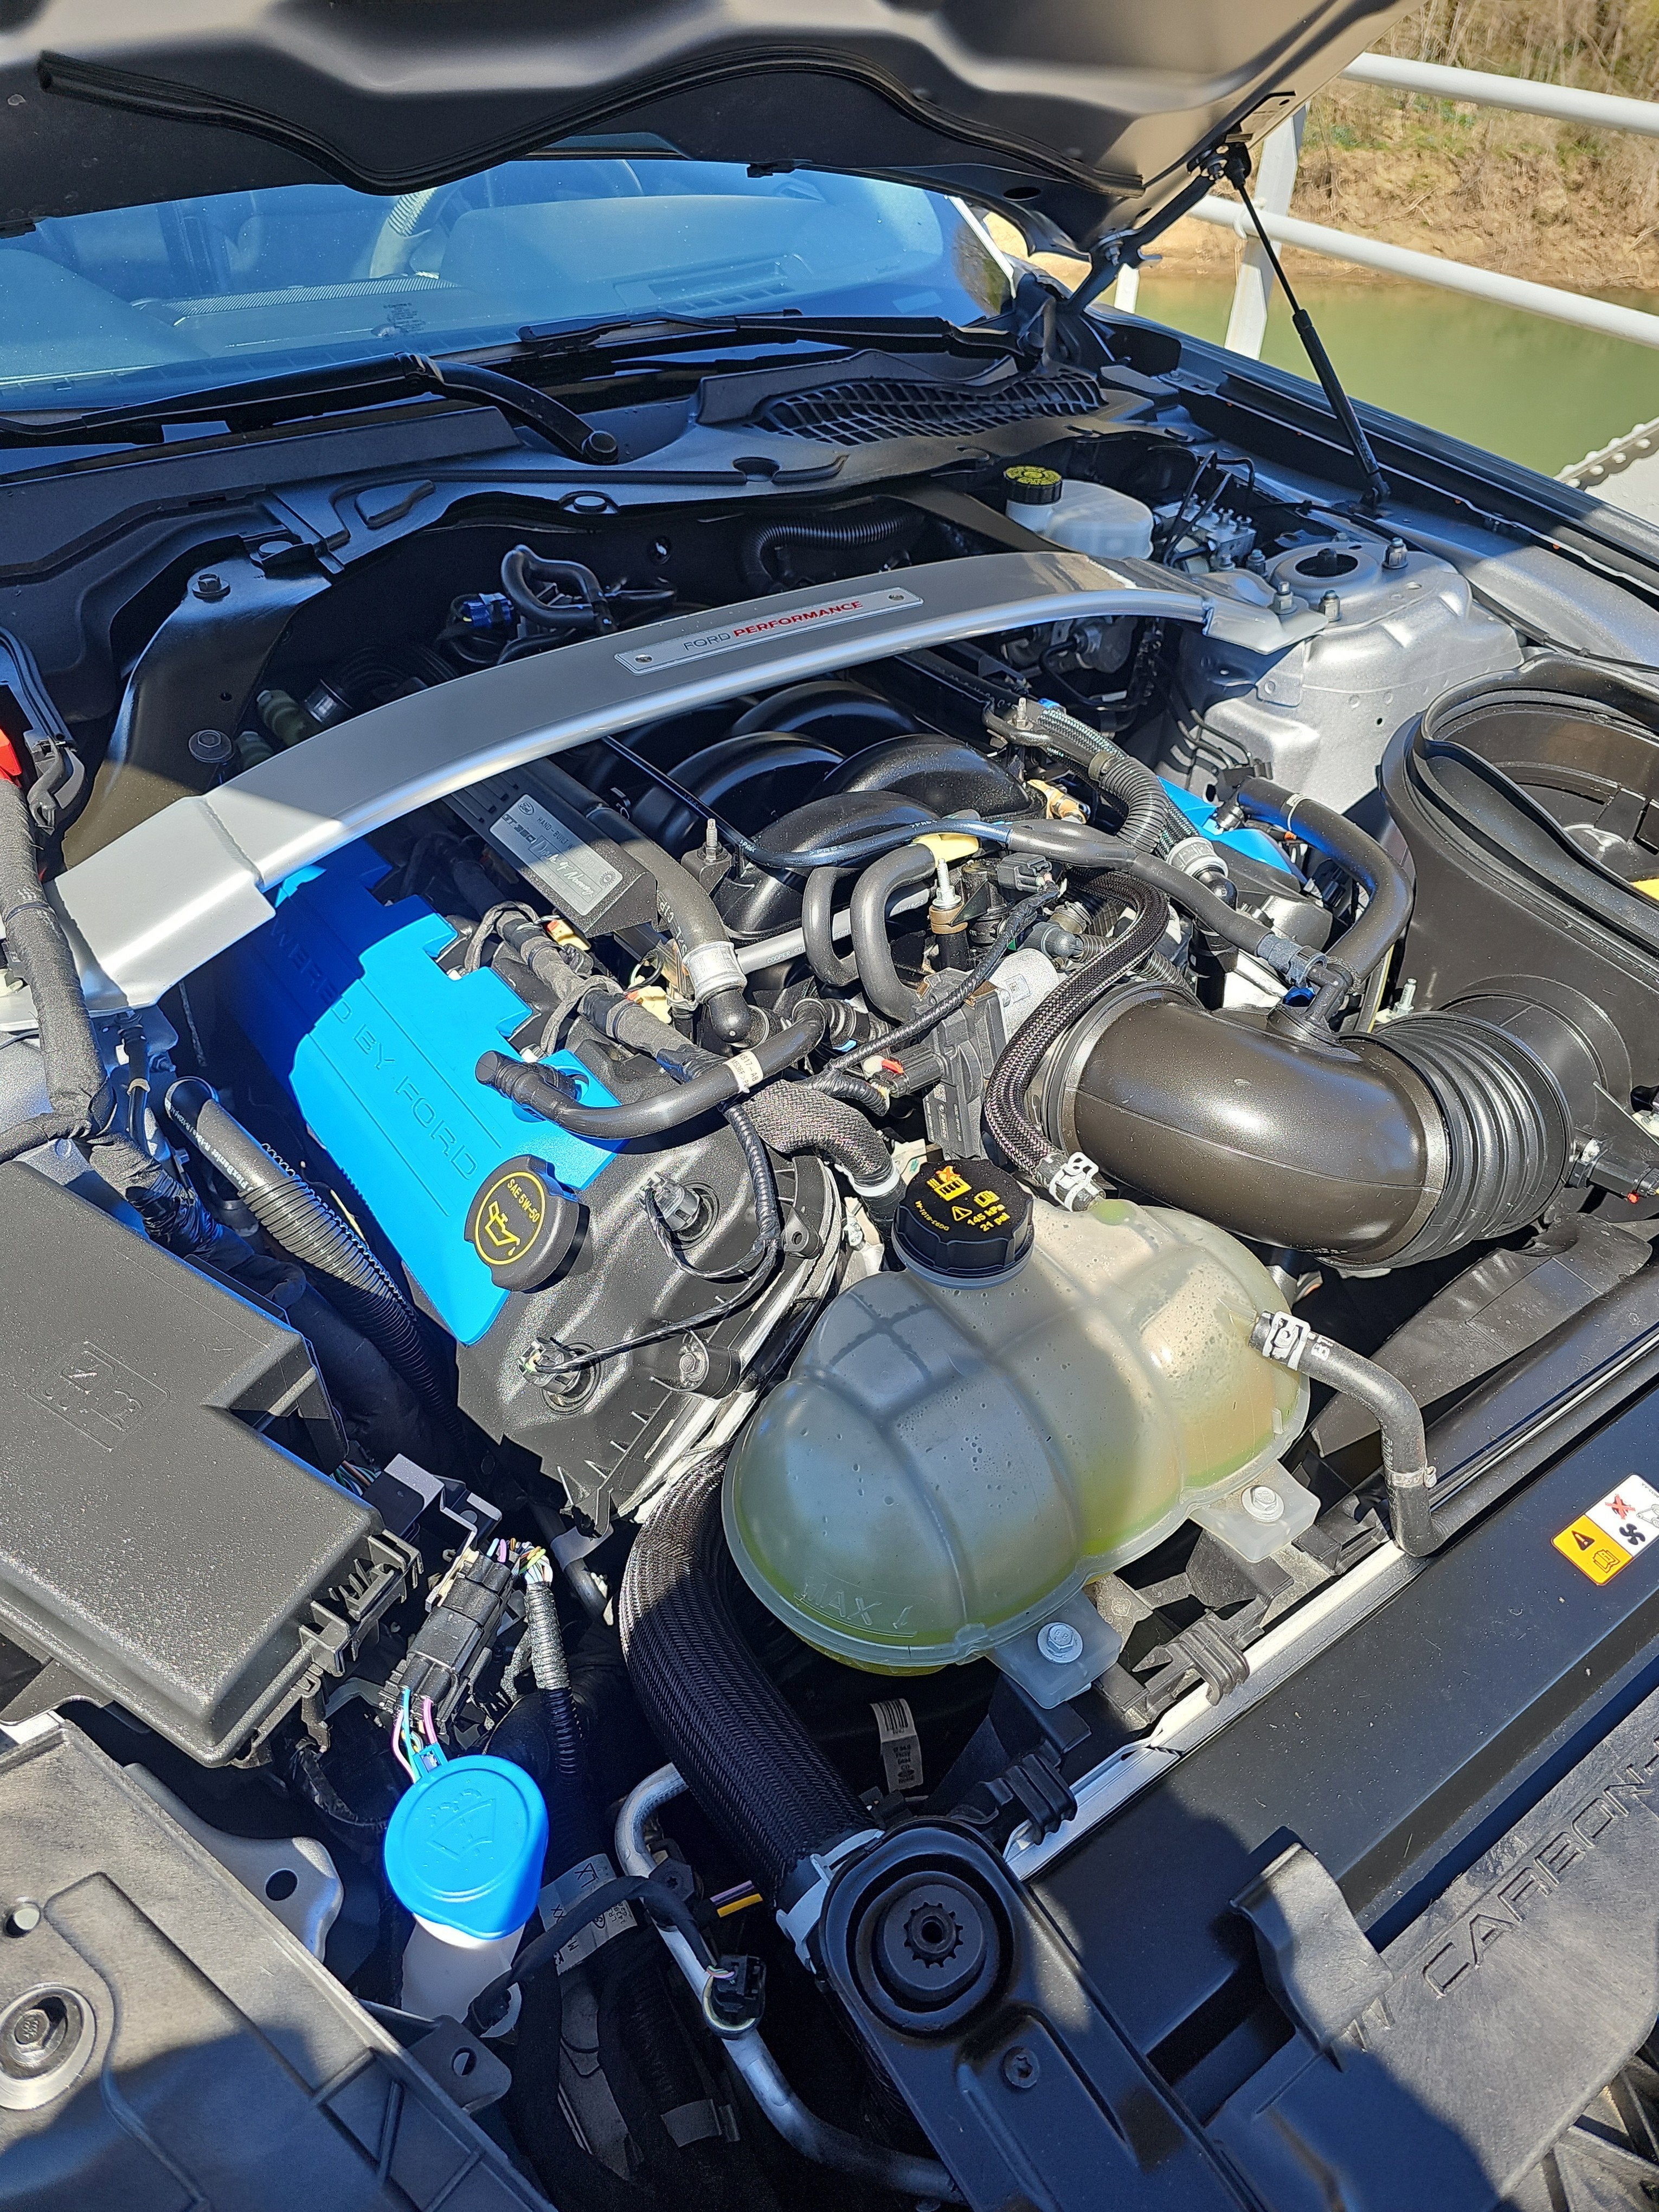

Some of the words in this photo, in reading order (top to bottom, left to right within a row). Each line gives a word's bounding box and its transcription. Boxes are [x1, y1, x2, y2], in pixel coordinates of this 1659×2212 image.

[682, 632, 732, 651] FORD
[733, 601, 864, 638] PERFORMANCE
[536, 815, 569, 845] HAND-BUILT
[353, 1023, 395, 1070] BY
[394, 1076, 480, 1181] FORD
[507, 1178, 522, 1198] SAE
[518, 1193, 540, 1223] 5W-50
[967, 1212, 986, 1226] 145
[979, 1220, 994, 1232] 21
[993, 1212, 1011, 1226] psi
[800, 1578, 883, 1626] MAX
